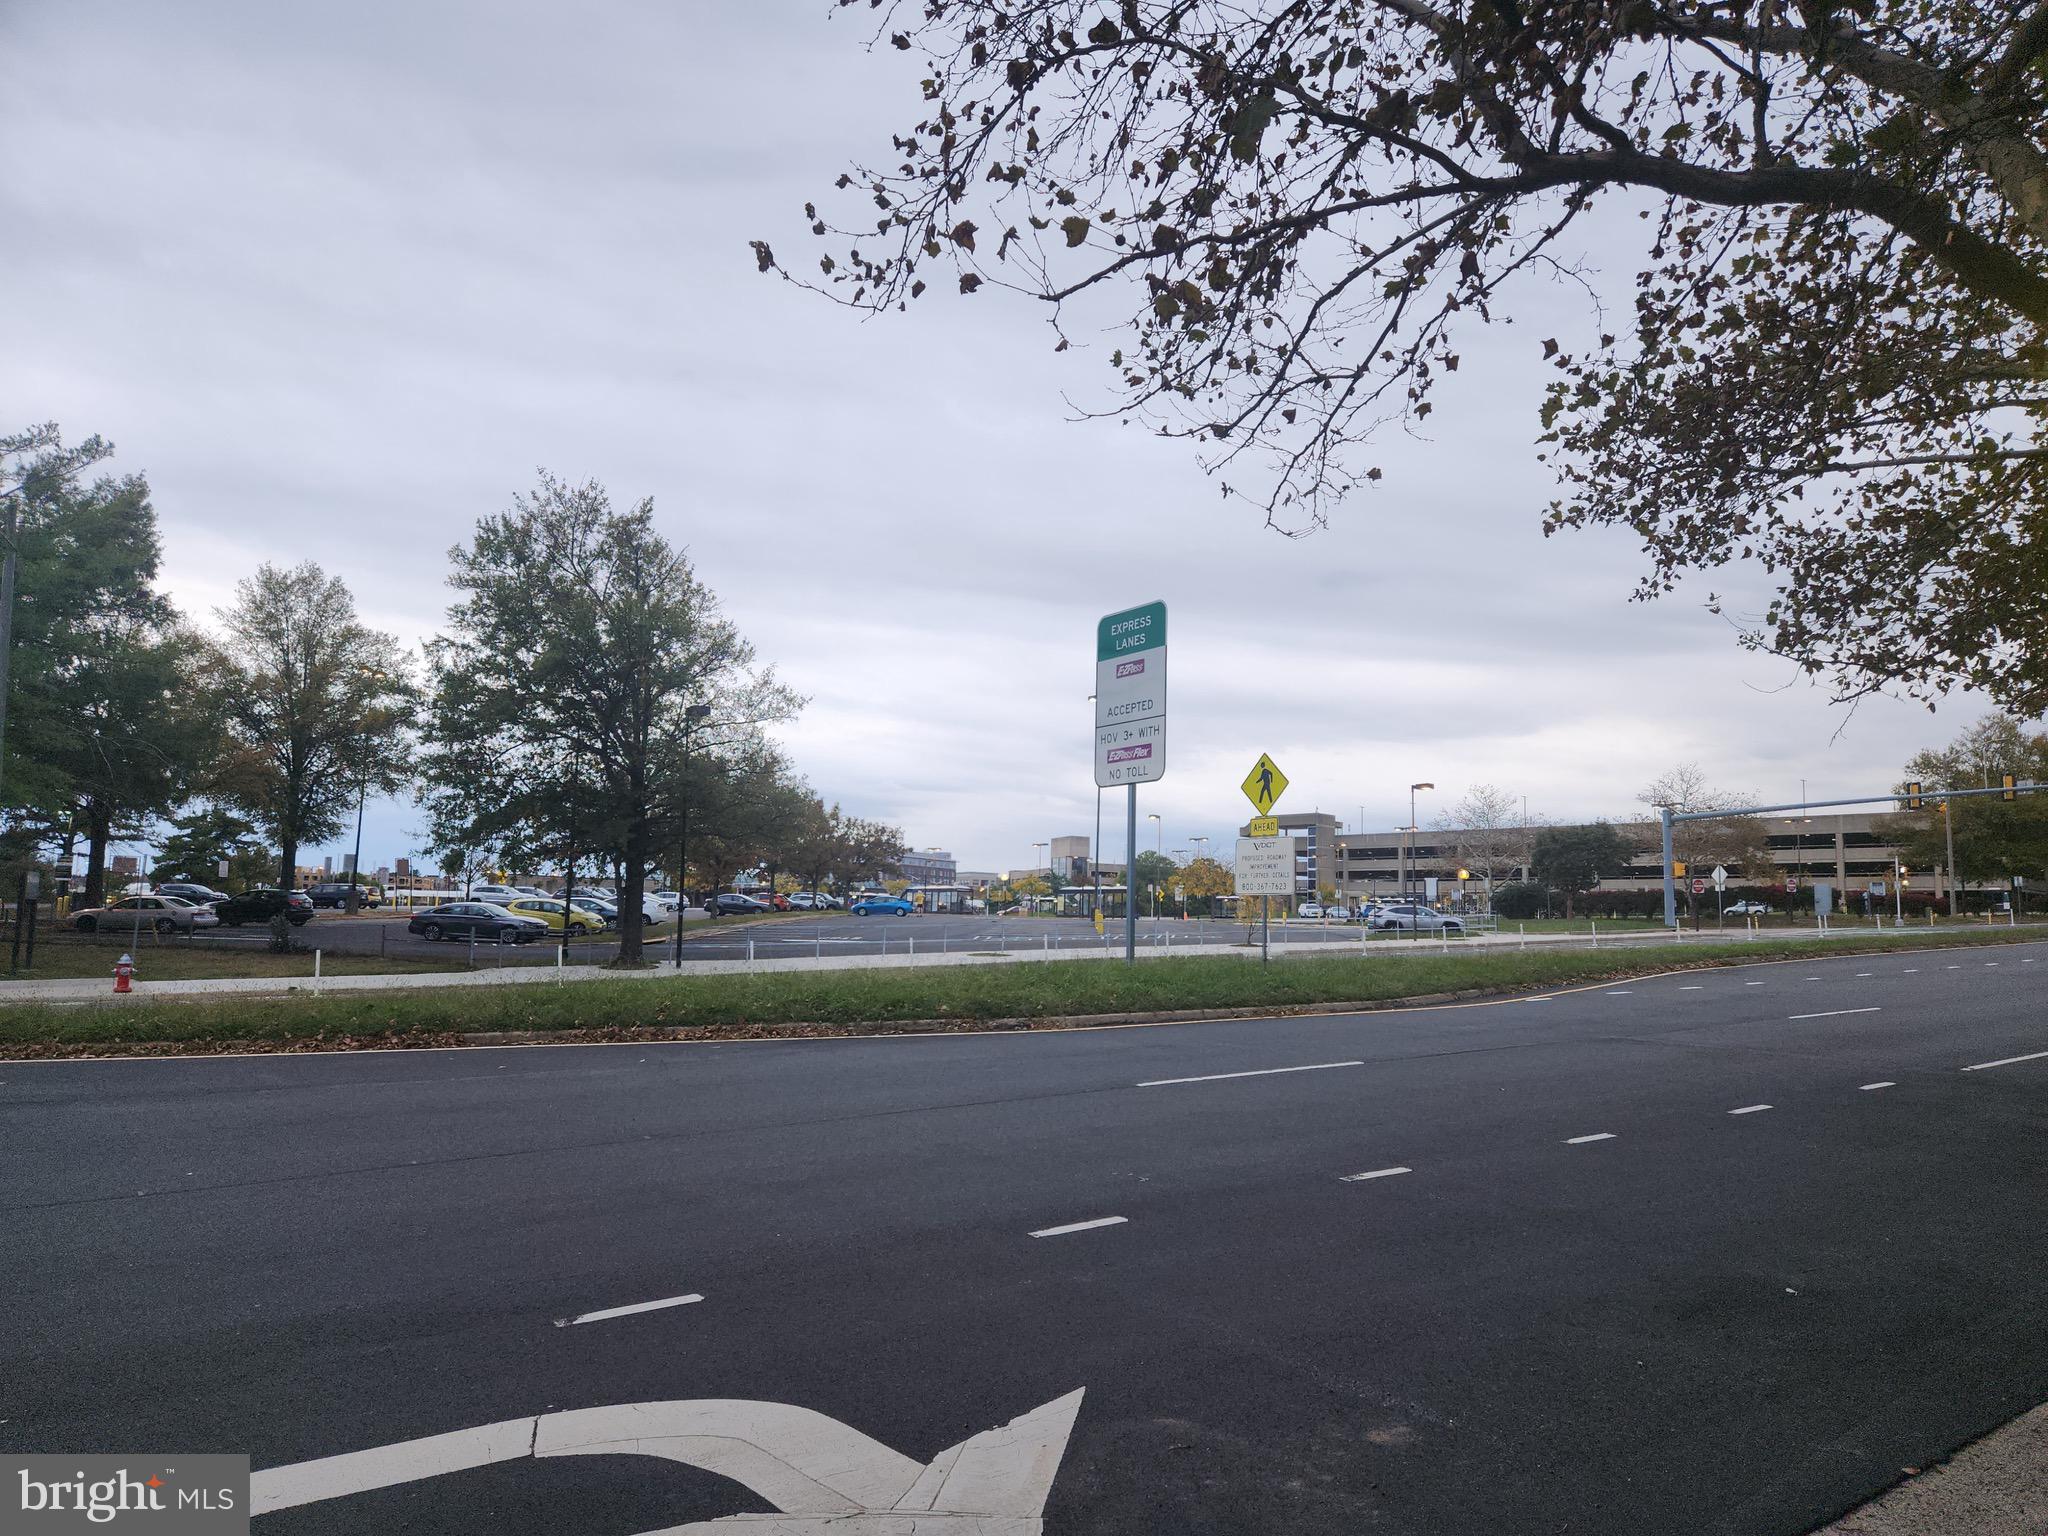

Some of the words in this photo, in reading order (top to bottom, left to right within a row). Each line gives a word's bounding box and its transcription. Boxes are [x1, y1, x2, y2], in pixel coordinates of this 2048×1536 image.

[1111, 615, 1152, 636] EXPRESS
[1116, 633, 1146, 651] LANES
[1107, 699, 1154, 718] ACCEPTED
[1100, 732, 1118, 745] HOV
[1123, 730, 1134, 741] 3+
[1138, 724, 1160, 738] WITH
[1109, 768, 1121, 780] NO
[1126, 765, 1149, 778] TOLL
[1254, 822, 1275, 831] AHEAD
[1253, 842, 1276, 850] VDOT
[1272, 871, 1290, 879] DETAILS
[1241, 882, 1287, 891] 800-367-7623
